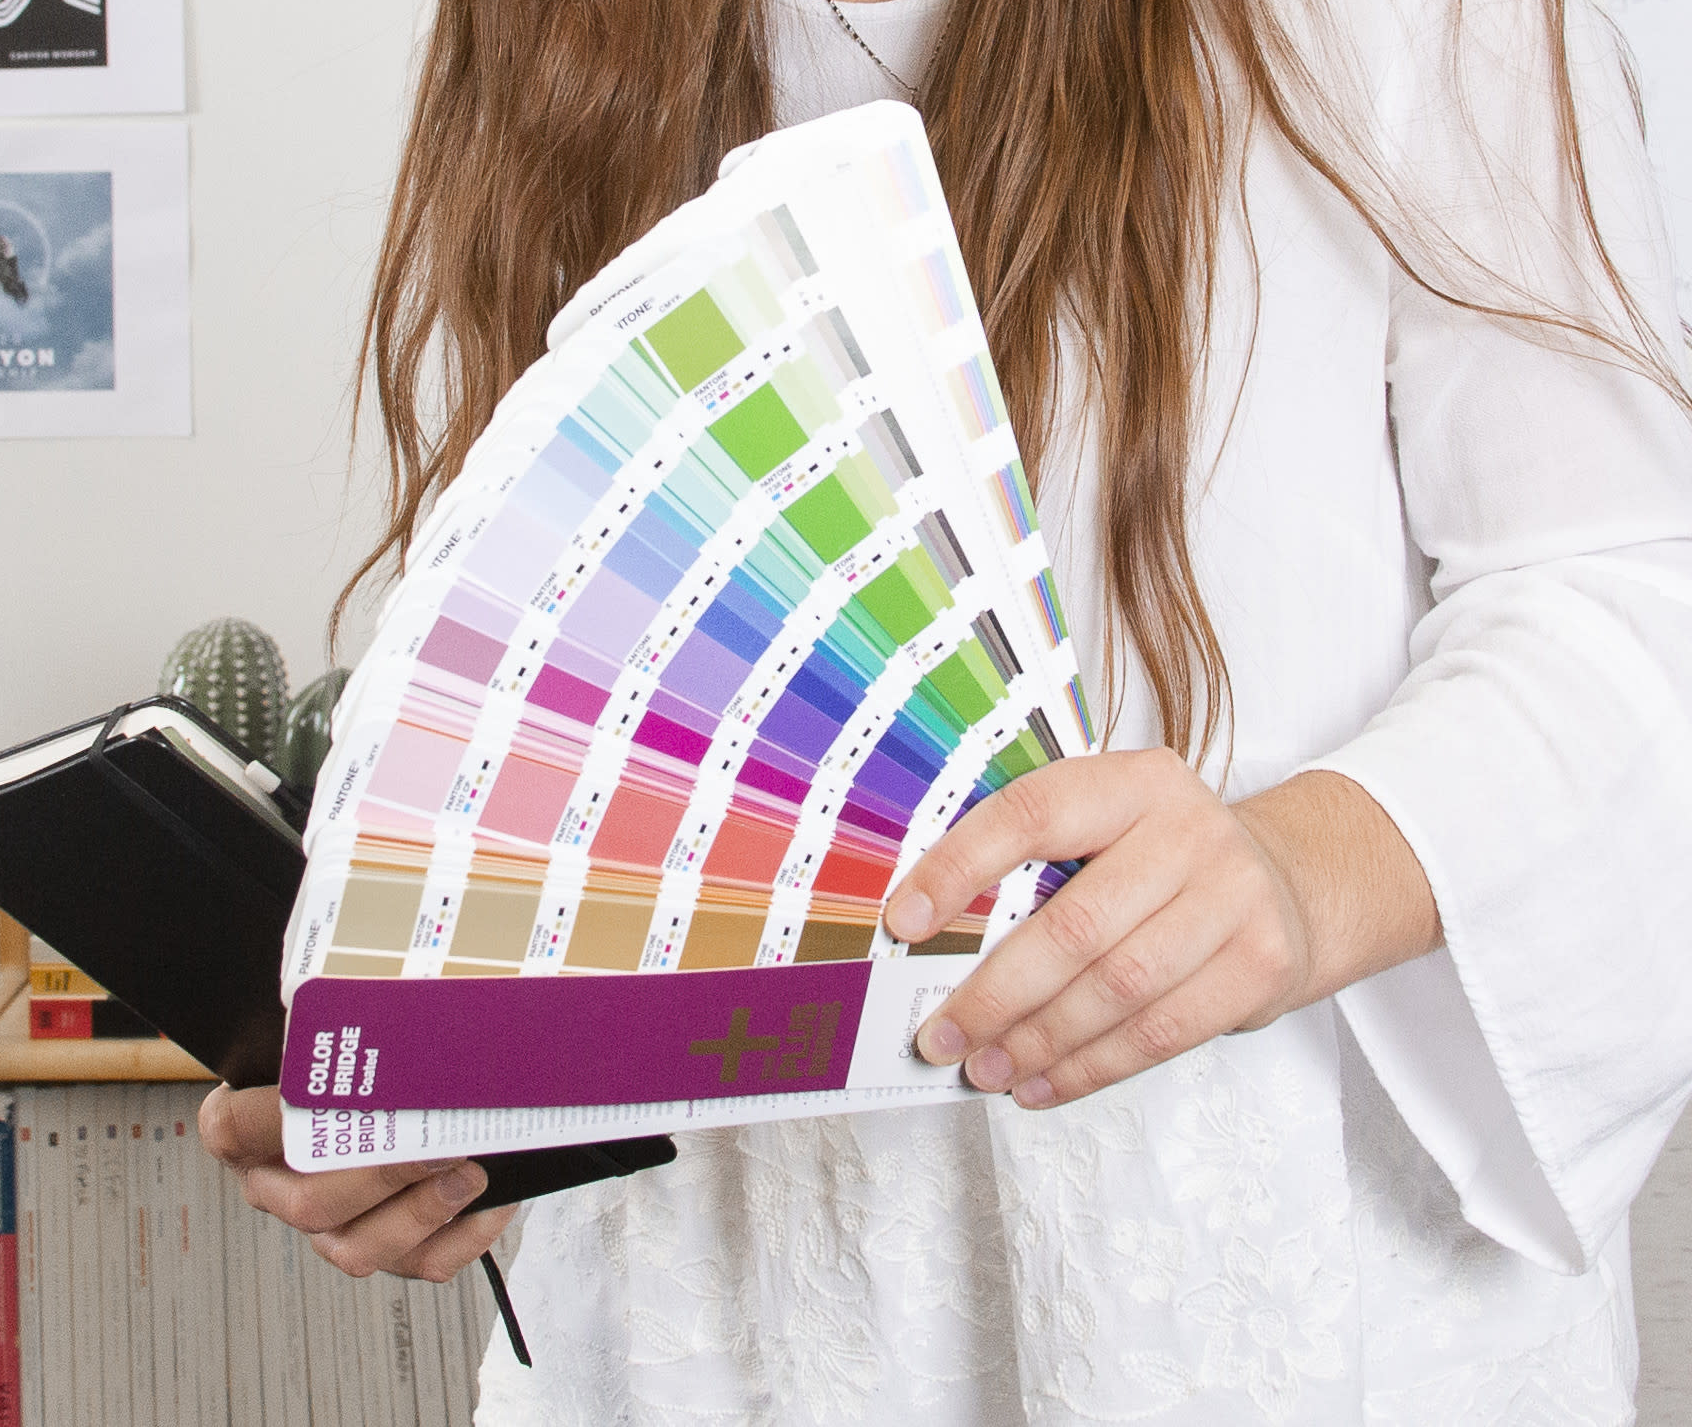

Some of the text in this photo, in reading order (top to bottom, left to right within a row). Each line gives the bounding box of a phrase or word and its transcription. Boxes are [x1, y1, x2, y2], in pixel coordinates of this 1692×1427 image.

[614, 300, 653, 330] NTONE
[694, 370, 728, 396] PANTONE
[531, 570, 556, 606] PANTONE
[628, 633, 650, 664] ANTONE
[635, 659, 643, 668] 64
[446, 773, 464, 810] PANTONE
[556, 806, 574, 842] PANTONE
[666, 837, 682, 869] ANTONE
[675, 856, 684, 870] 787
[325, 901, 336, 923] CMYK
[413, 913, 427, 947] PANTONE
[529, 923, 543, 957] PANTONE
[299, 924, 320, 975] PANTONE
[642, 933, 656, 966] PANTONE
[308, 1031, 334, 1095] COLOR
[333, 1026, 361, 1096] BRIDGE
[358, 1048, 379, 1096] Coated
[335, 1109, 351, 1156] COLO
